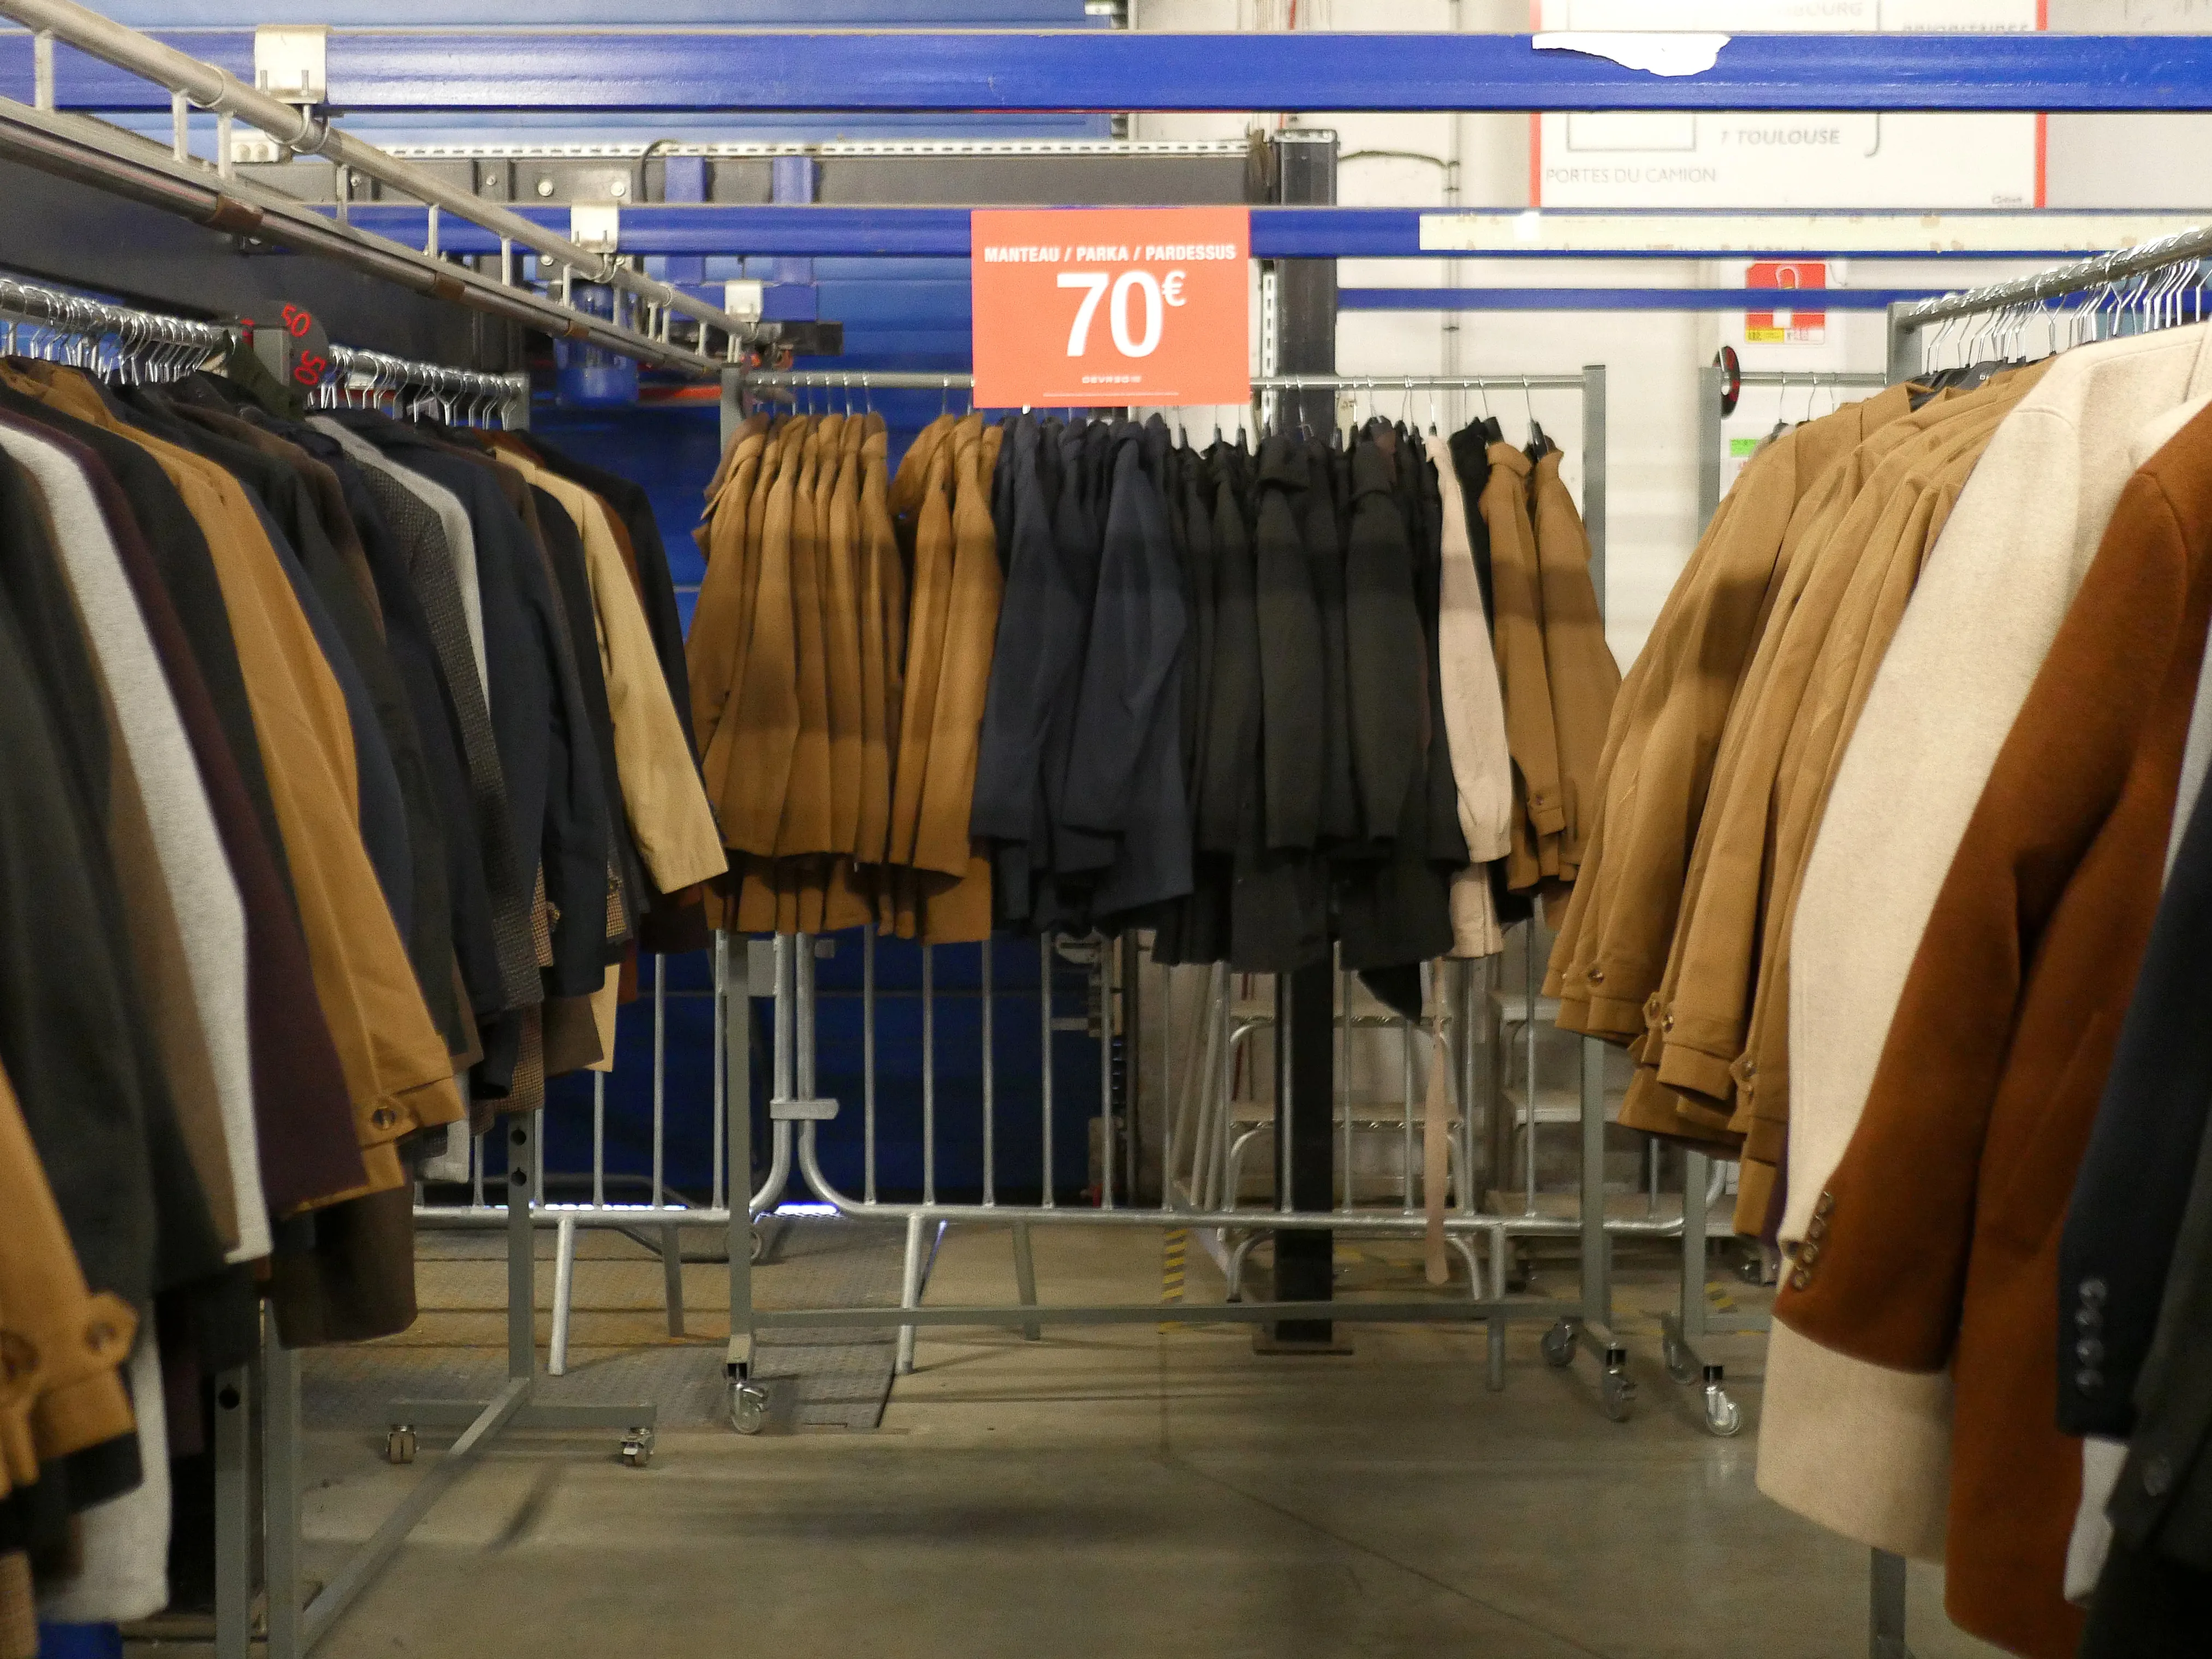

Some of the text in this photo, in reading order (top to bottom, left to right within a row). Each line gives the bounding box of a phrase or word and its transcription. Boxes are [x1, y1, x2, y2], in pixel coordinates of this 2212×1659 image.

[1737, 129, 1840, 145] TOULOUSE
[1546, 168, 1716, 183] PORTES DU CAMION
[984, 246, 1060, 263] MANTEAU
[1076, 246, 1128, 261] PARKA
[1145, 244, 1236, 261] PARDESSUS
[281, 302, 311, 337] 50
[1057, 269, 1186, 358] 70€
[294, 349, 326, 385] 50
